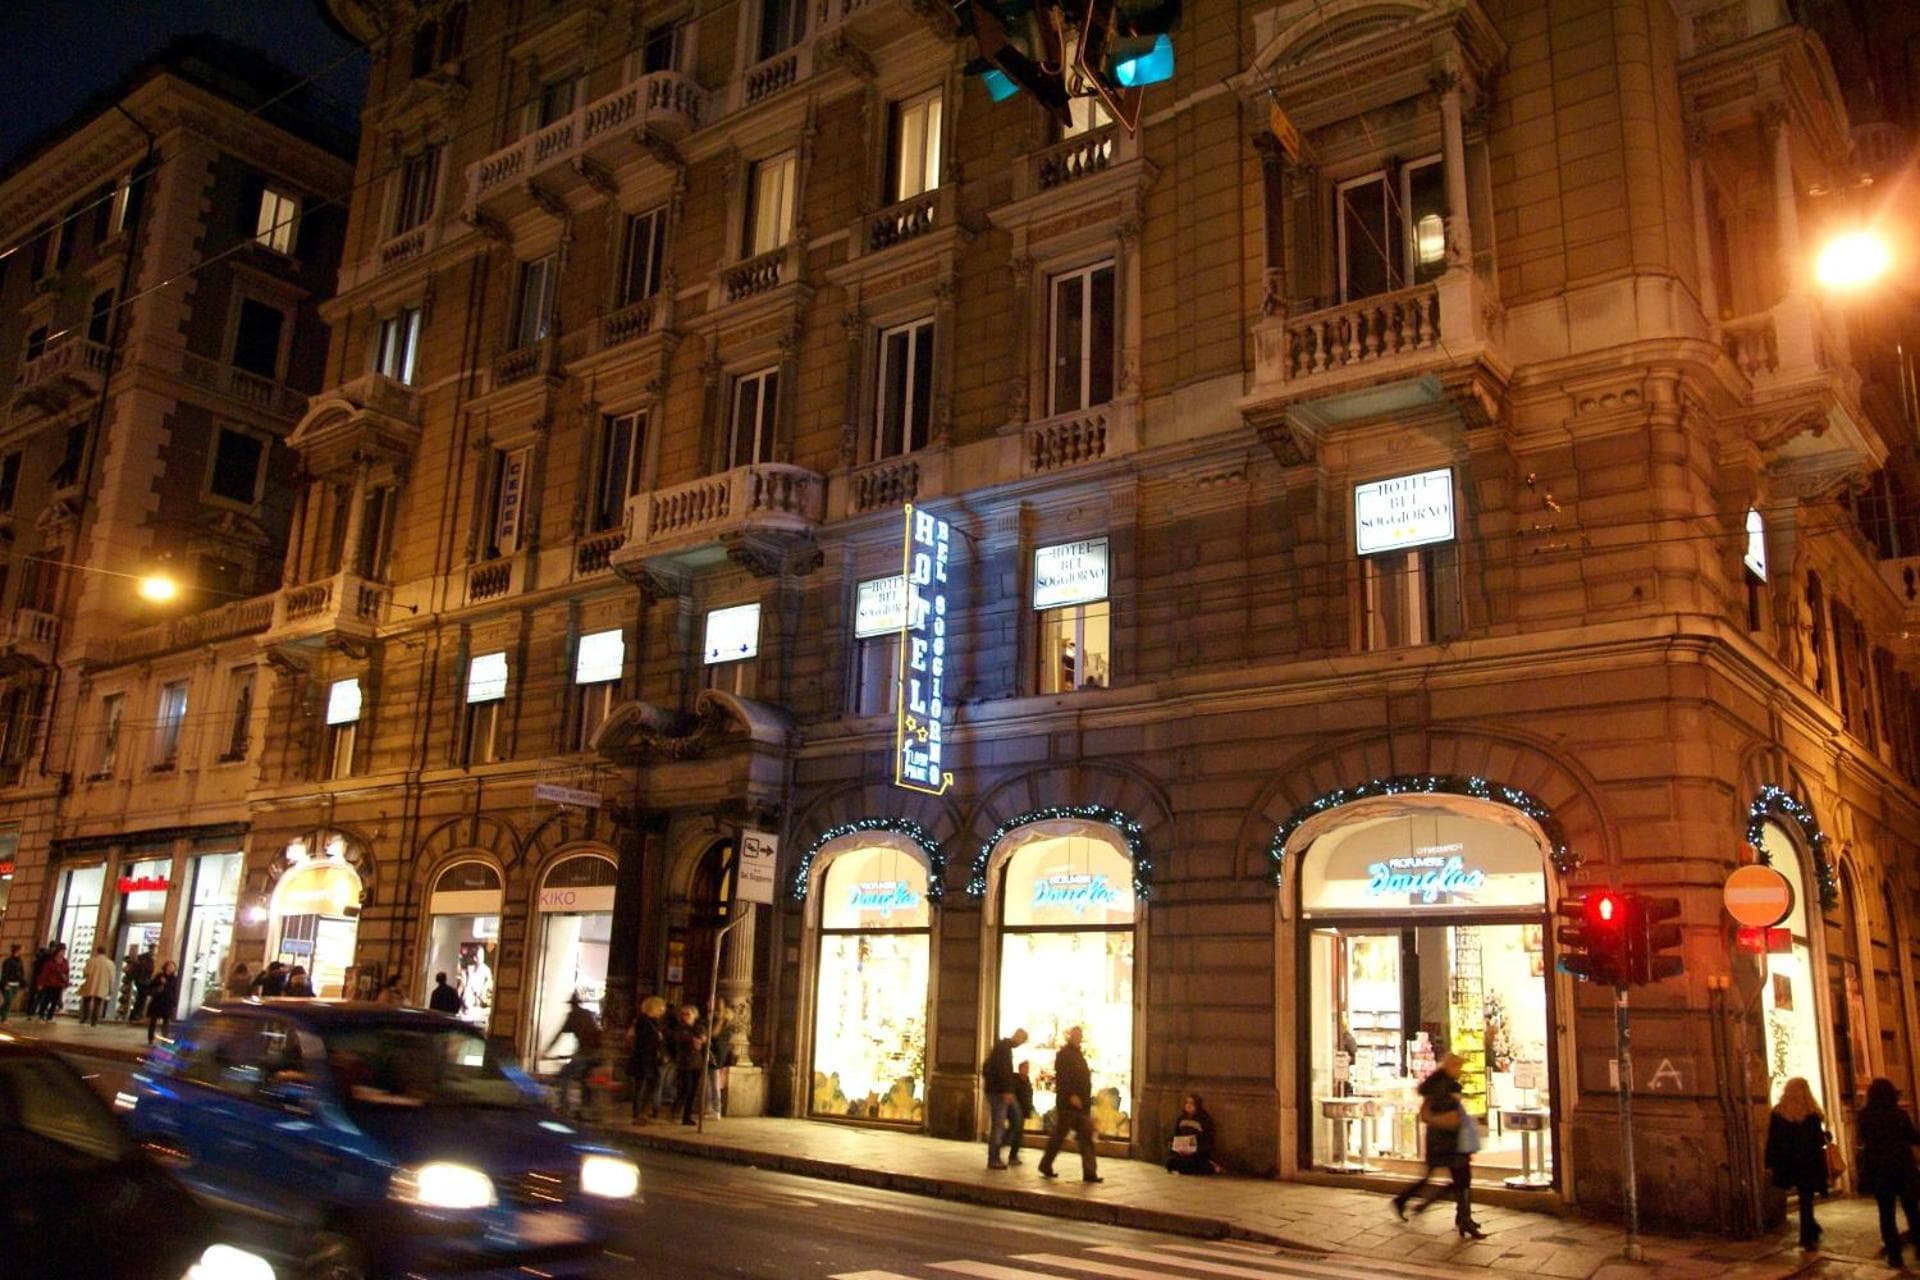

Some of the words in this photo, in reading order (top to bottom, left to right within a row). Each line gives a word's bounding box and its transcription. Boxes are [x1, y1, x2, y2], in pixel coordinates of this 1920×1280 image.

[1379, 476, 1428, 496] HOTEL
[1390, 493, 1418, 508] BEL
[1361, 504, 1447, 528] SOGGIORNO
[936, 520, 949, 583] BEL
[1053, 542, 1093, 558] HOTEL
[1060, 557, 1083, 570] BEL
[1038, 567, 1105, 588] SOGGIORNO
[879, 590, 898, 602] BEL
[910, 510, 934, 714] HOTEL
[929, 595, 946, 786] SOGGIORNO
[1364, 856, 1484, 902] Douglas
[540, 891, 576, 906] KIKO
[850, 880, 919, 917] Douglas
[1031, 875, 1118, 916] Douglas
